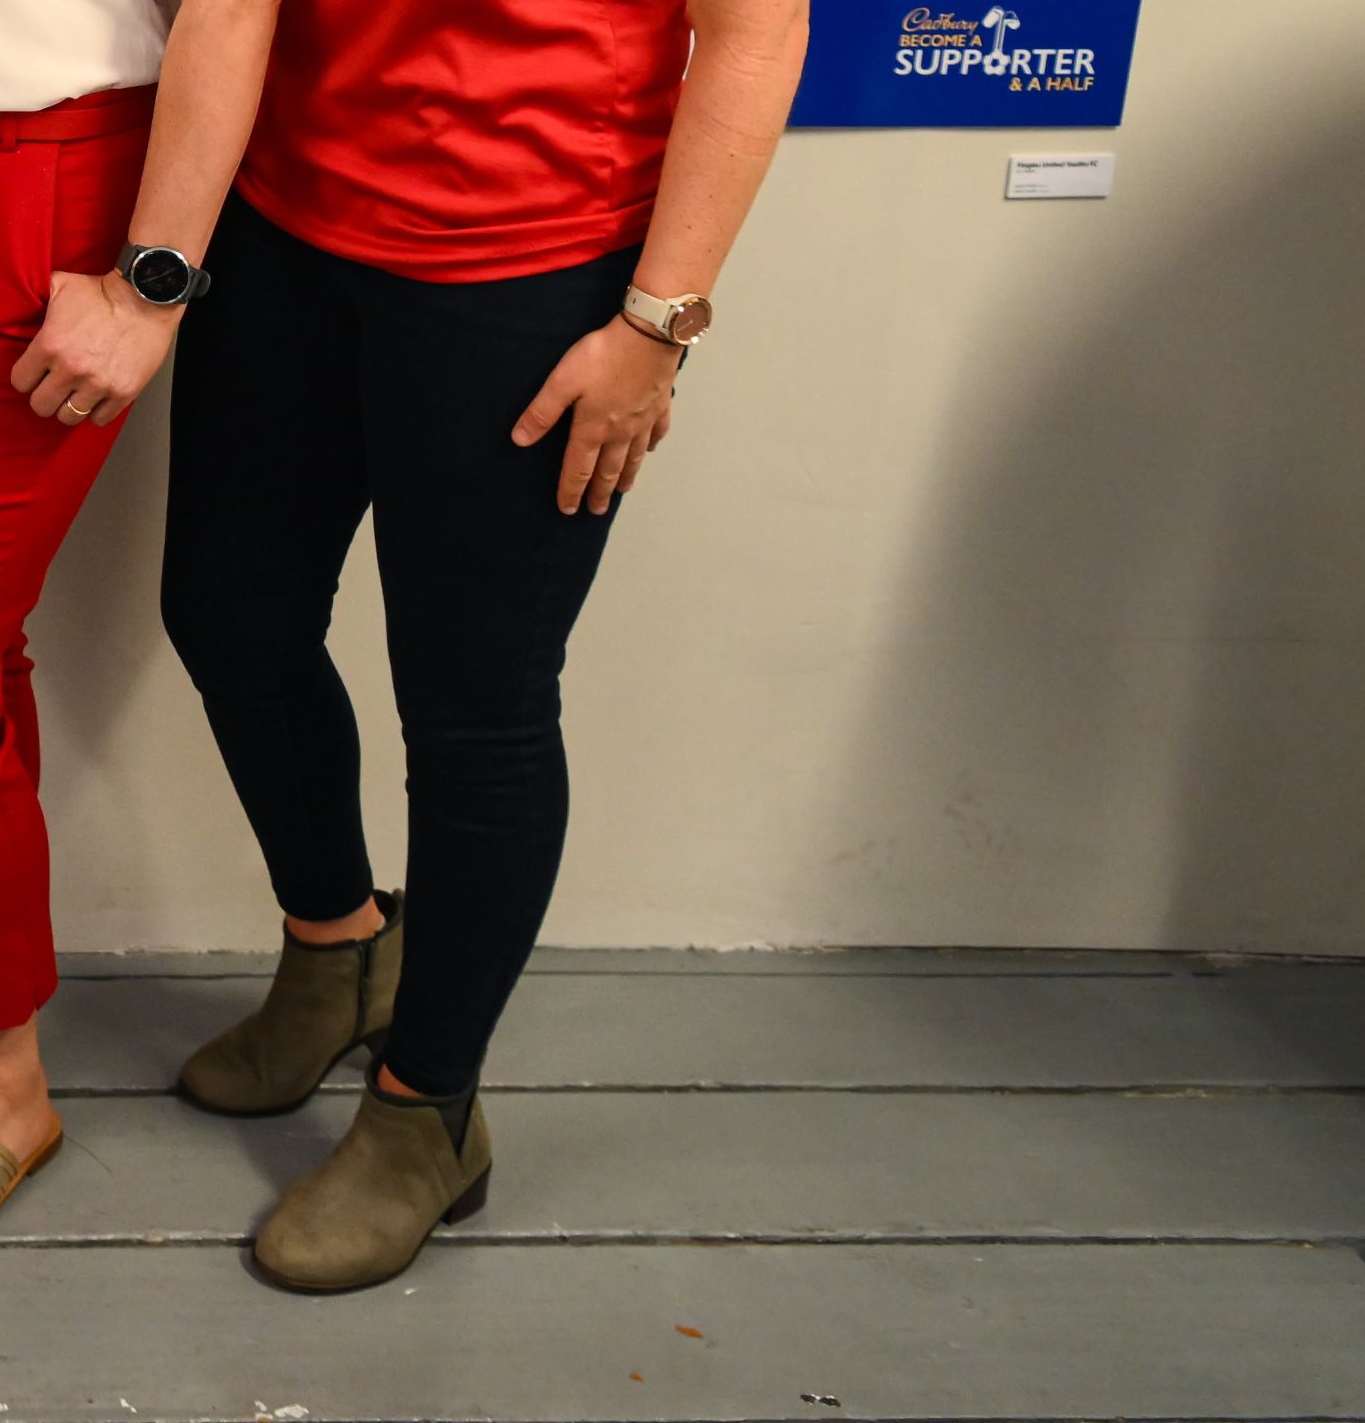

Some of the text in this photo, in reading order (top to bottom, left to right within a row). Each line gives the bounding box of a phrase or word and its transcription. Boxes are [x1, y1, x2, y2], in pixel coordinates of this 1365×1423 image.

[902, 7, 978, 34] Cadbury
[900, 35, 982, 47] BECOME A
[894, 49, 1095, 76] SUPPORTER
[1009, 77, 1094, 91] & A HALF
